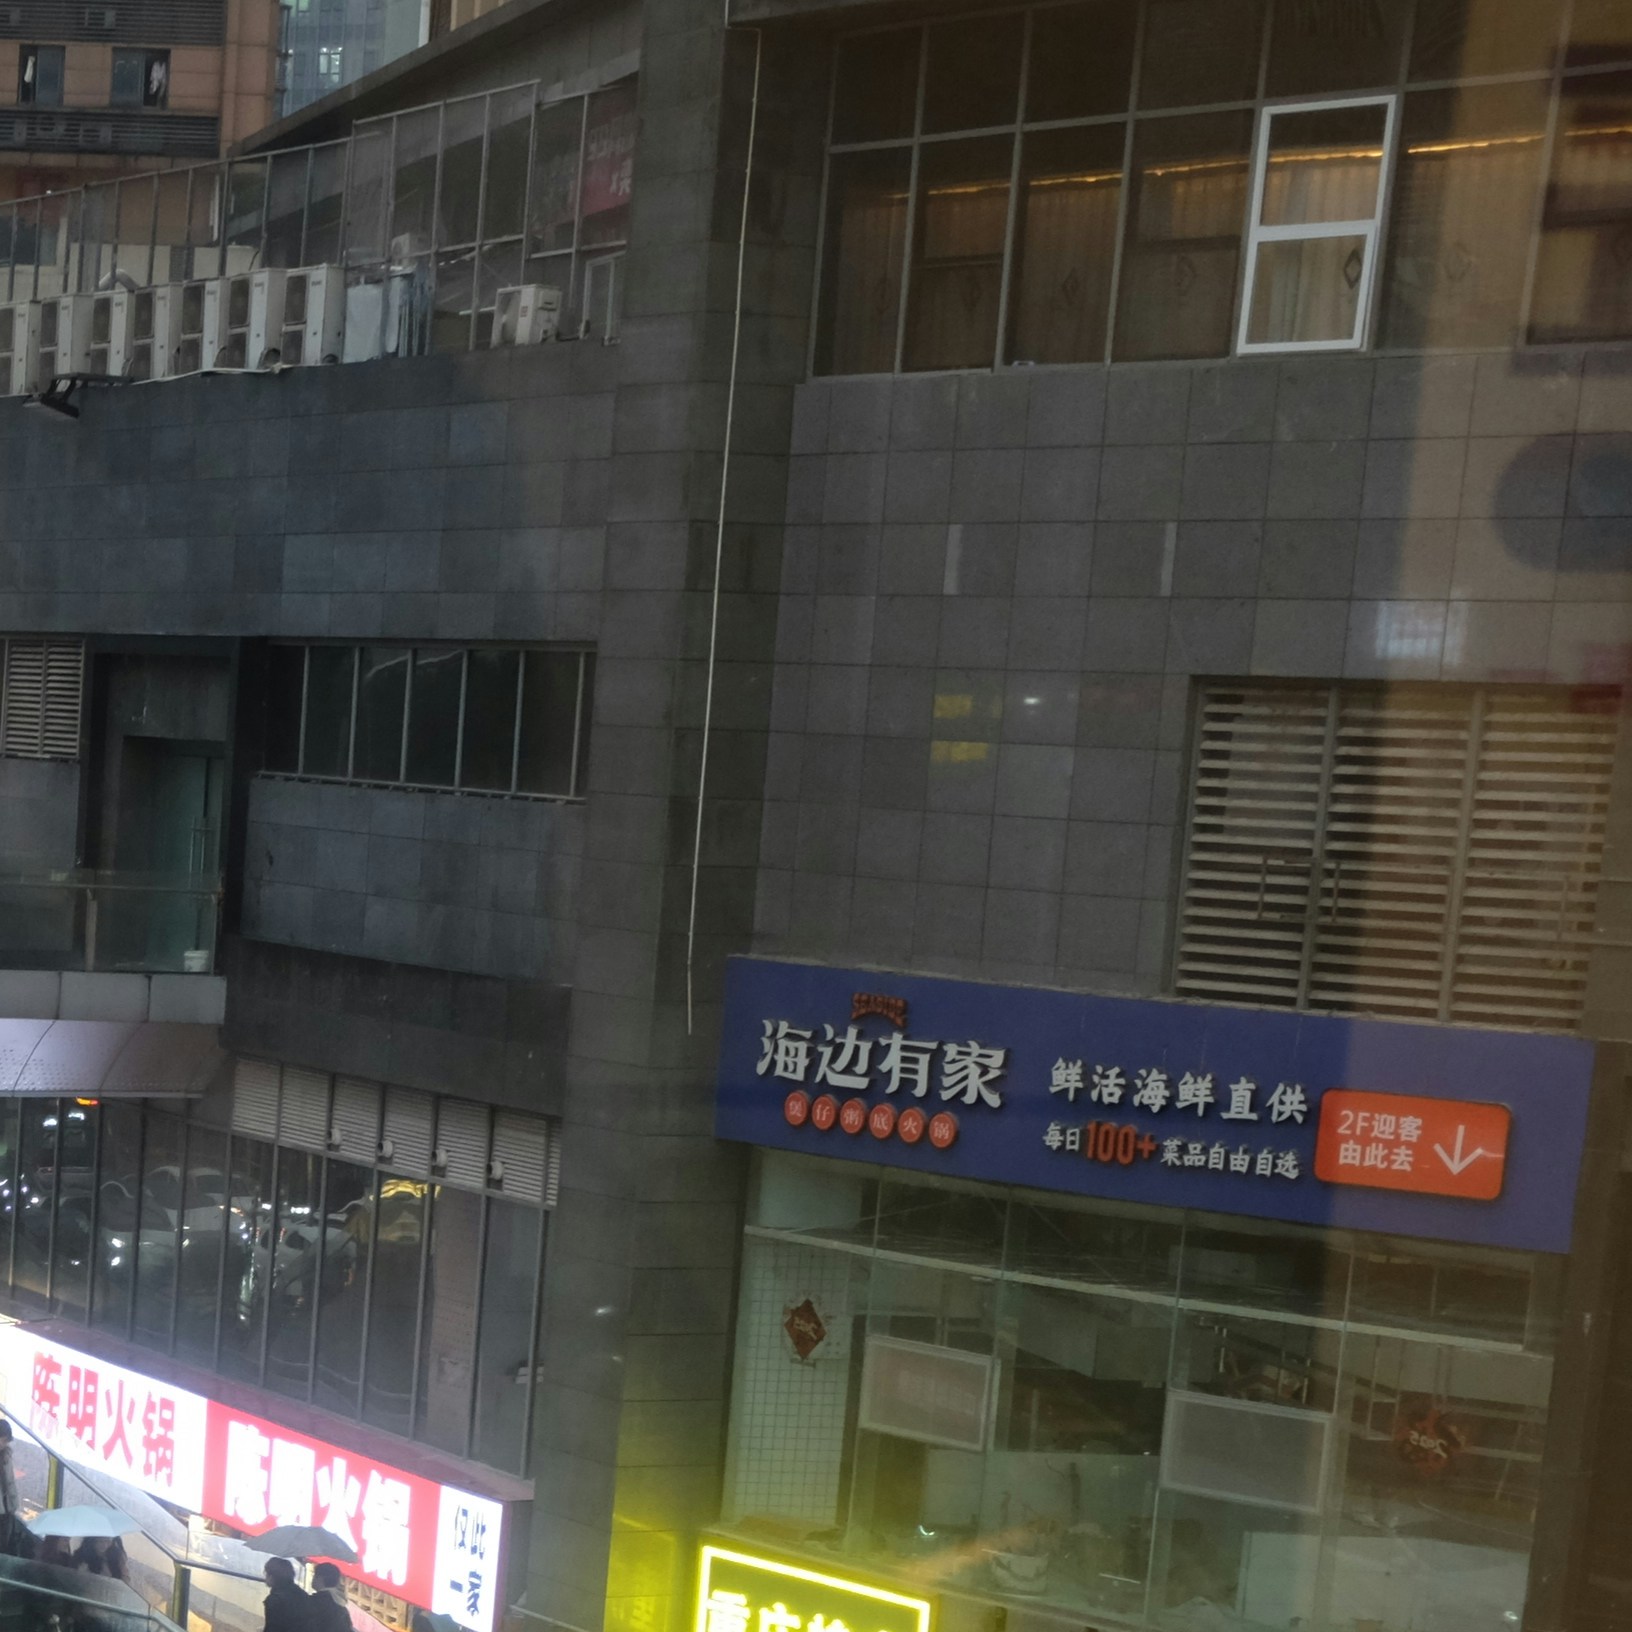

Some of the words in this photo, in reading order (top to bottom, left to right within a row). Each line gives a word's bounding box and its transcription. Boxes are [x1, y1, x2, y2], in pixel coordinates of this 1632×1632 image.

[756, 1018, 1007, 1109] 海边有家
[1048, 1057, 1309, 1125] 鲜活海鲜直供
[787, 1097, 954, 1142] 煲仔粥底火锅
[1337, 1109, 1423, 1143] 2F迎客
[1338, 1139, 1414, 1172] 由此去
